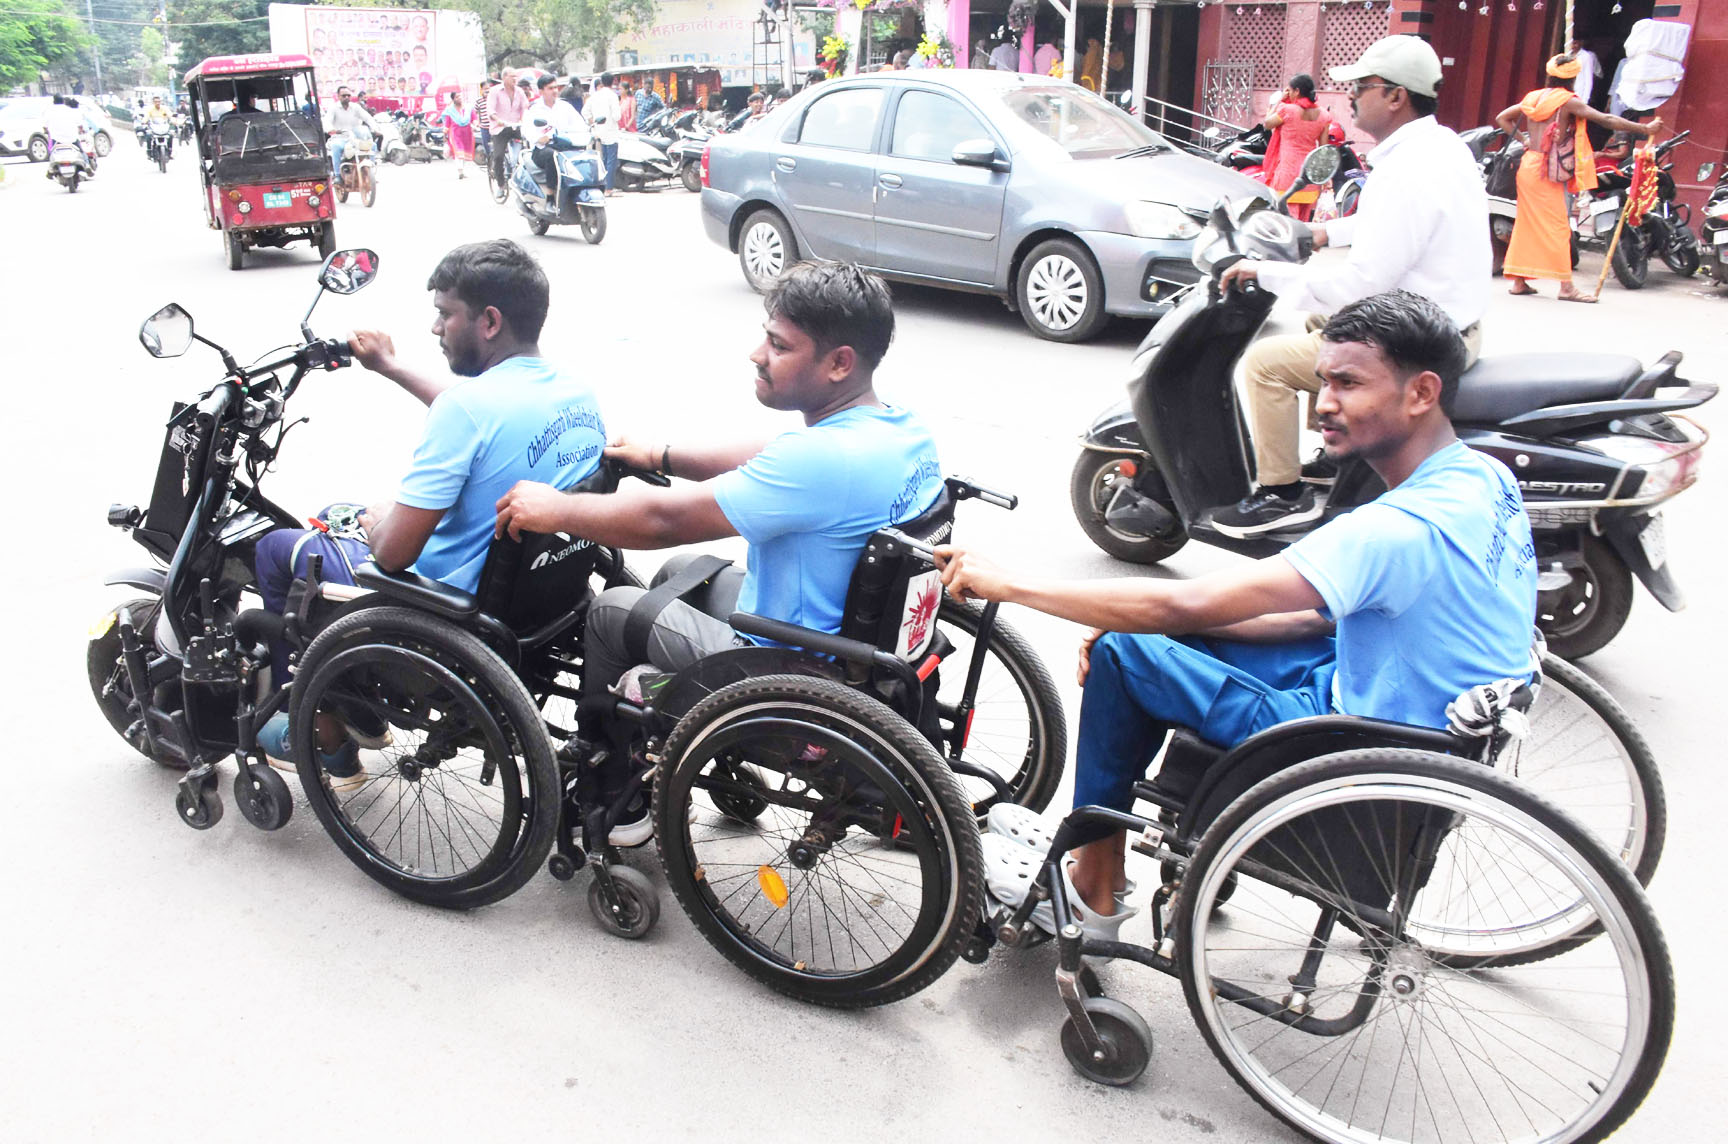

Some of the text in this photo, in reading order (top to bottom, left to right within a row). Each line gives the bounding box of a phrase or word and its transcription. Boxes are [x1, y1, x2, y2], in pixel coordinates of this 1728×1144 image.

[556, 443, 599, 468] Association
[1518, 481, 1606, 495] AESTRO
[548, 538, 595, 565] NEOMO
